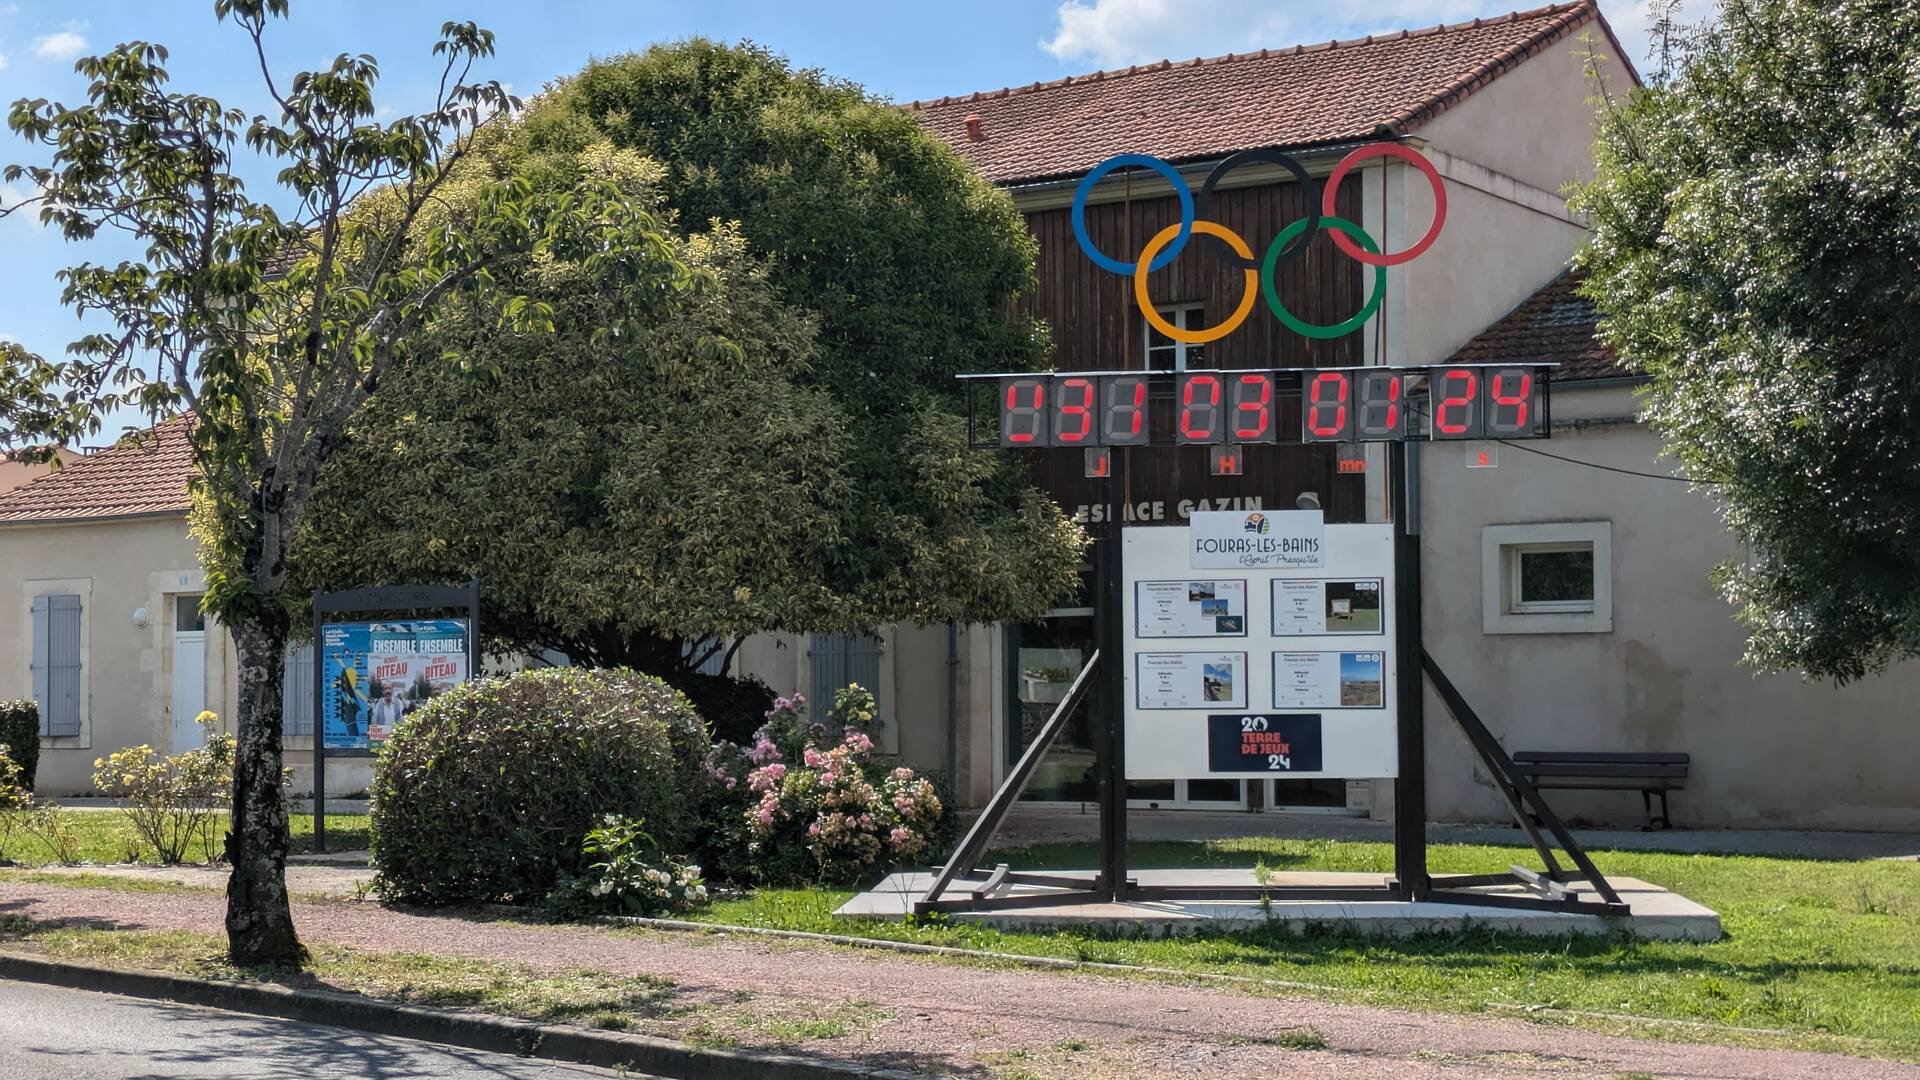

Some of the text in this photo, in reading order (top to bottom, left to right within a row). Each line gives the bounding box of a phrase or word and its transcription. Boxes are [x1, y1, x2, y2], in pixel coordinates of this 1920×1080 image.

[1308, 372, 1399, 436] 01
[1439, 369, 1528, 434] 24
[1218, 456, 1236, 475] H
[1339, 459, 1366, 473] mn
[1196, 538, 1320, 554] FOURAS-LES-BAINS
[373, 639, 417, 653] ENSEMBLE
[420, 638, 463, 653] ENSEMBLE
[376, 662, 408, 678] BITEAU
[425, 662, 457, 679] BITEAU
[1241, 716, 1268, 732] 20
[1241, 732, 1281, 743] TERRE
[1241, 743, 1290, 754] DE JEUX
[1268, 754, 1291, 770] 24
